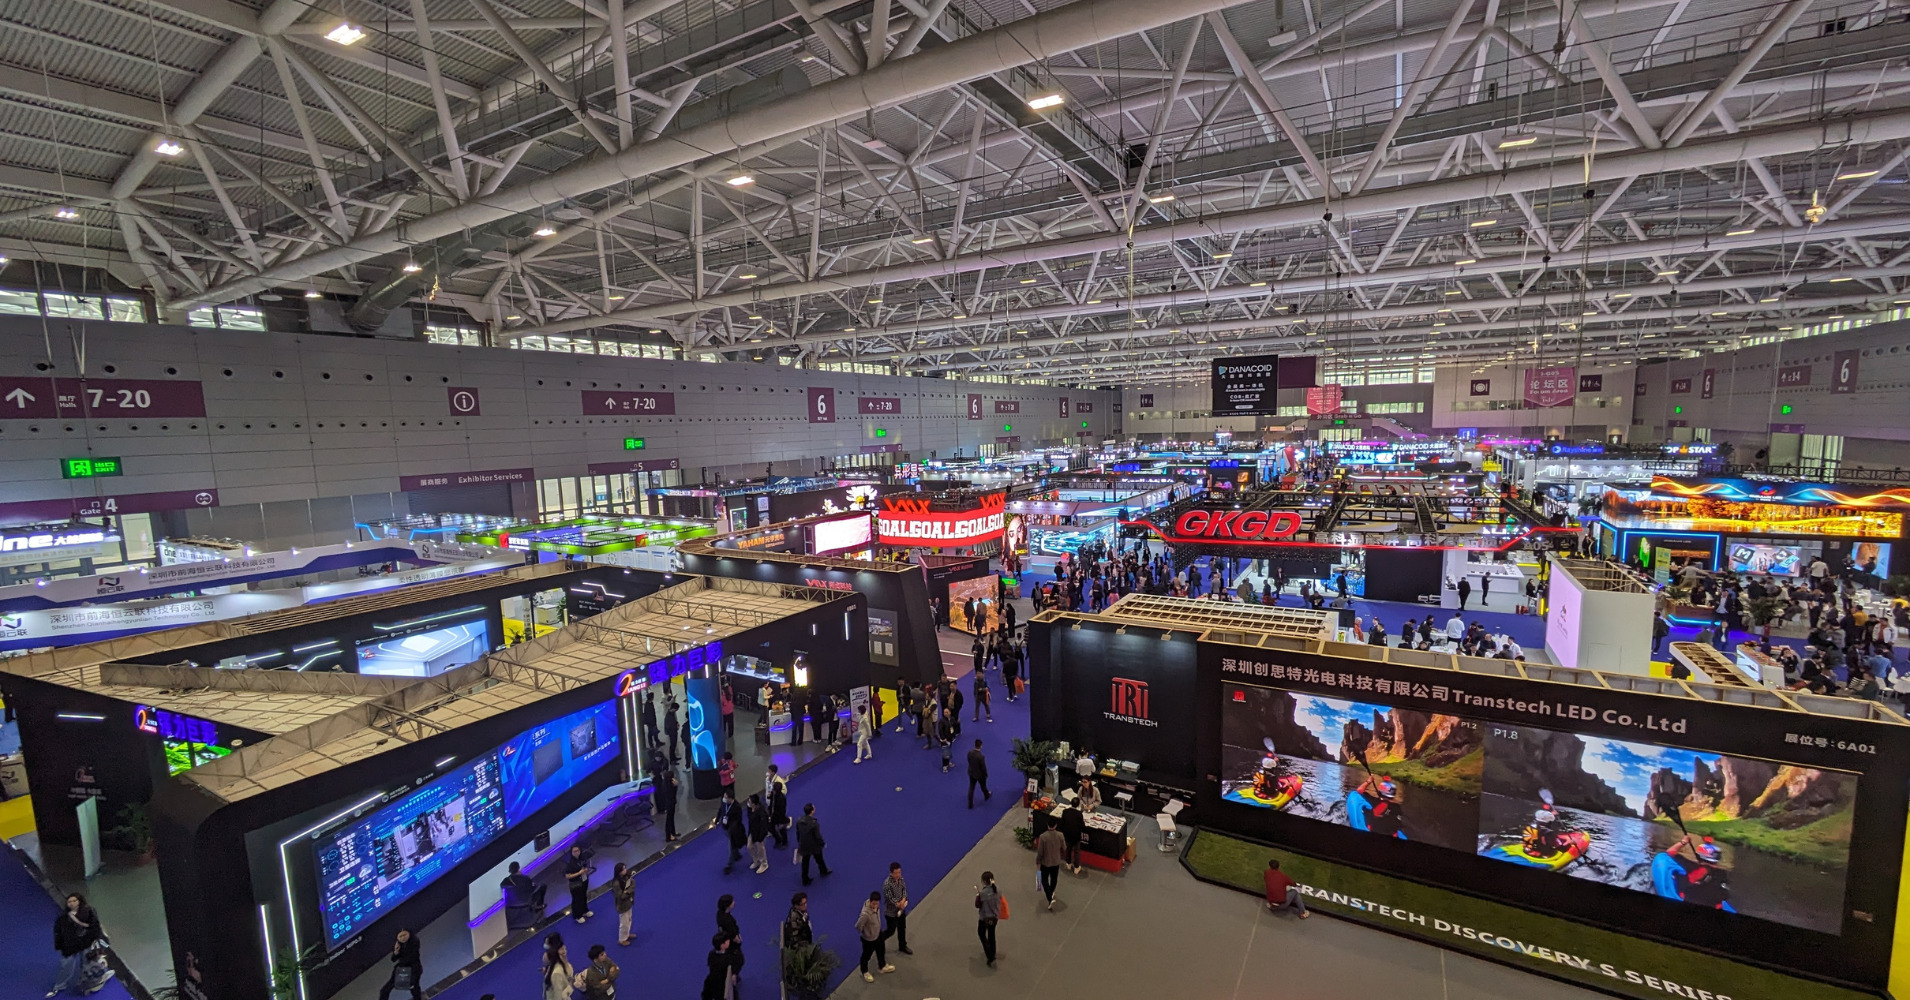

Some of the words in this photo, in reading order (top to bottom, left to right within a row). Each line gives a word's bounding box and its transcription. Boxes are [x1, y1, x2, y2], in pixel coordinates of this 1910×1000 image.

[1228, 364, 1272, 373] DANACOID
[1840, 358, 1850, 383] 6
[1530, 379, 1568, 389] 论坛区
[1705, 375, 1710, 391] 6
[87, 389, 151, 408] 7-20
[632, 398, 656, 410] 7-20
[817, 395, 826, 414] 6
[880, 402, 893, 411] 7-20
[972, 399, 978, 414] 6
[1688, 446, 1713, 454] STAR
[638, 462, 643, 471] 5
[458, 475, 493, 484] Exhibitor
[493, 473, 523, 481] Services
[105, 498, 118, 513] 4
[1174, 510, 1302, 538] GKGD
[737, 536, 765, 550] YAHAM
[50, 601, 215, 624] 深圳市前海恒云联科技有限公司
[51, 622, 86, 631] Shenzhen
[153, 613, 190, 622] Technology
[1221, 657, 1449, 703] 深圳创思特光电科技有限公司
[1452, 689, 1551, 716] Transtech
[1555, 703, 1597, 721] LED
[1103, 711, 1159, 728] TRANSTECH
[1460, 721, 1478, 730] P1.2
[1493, 728, 1519, 741] P1.8
[1434, 918, 1591, 970] DISCOVERY
[1600, 963, 1619, 978] S
